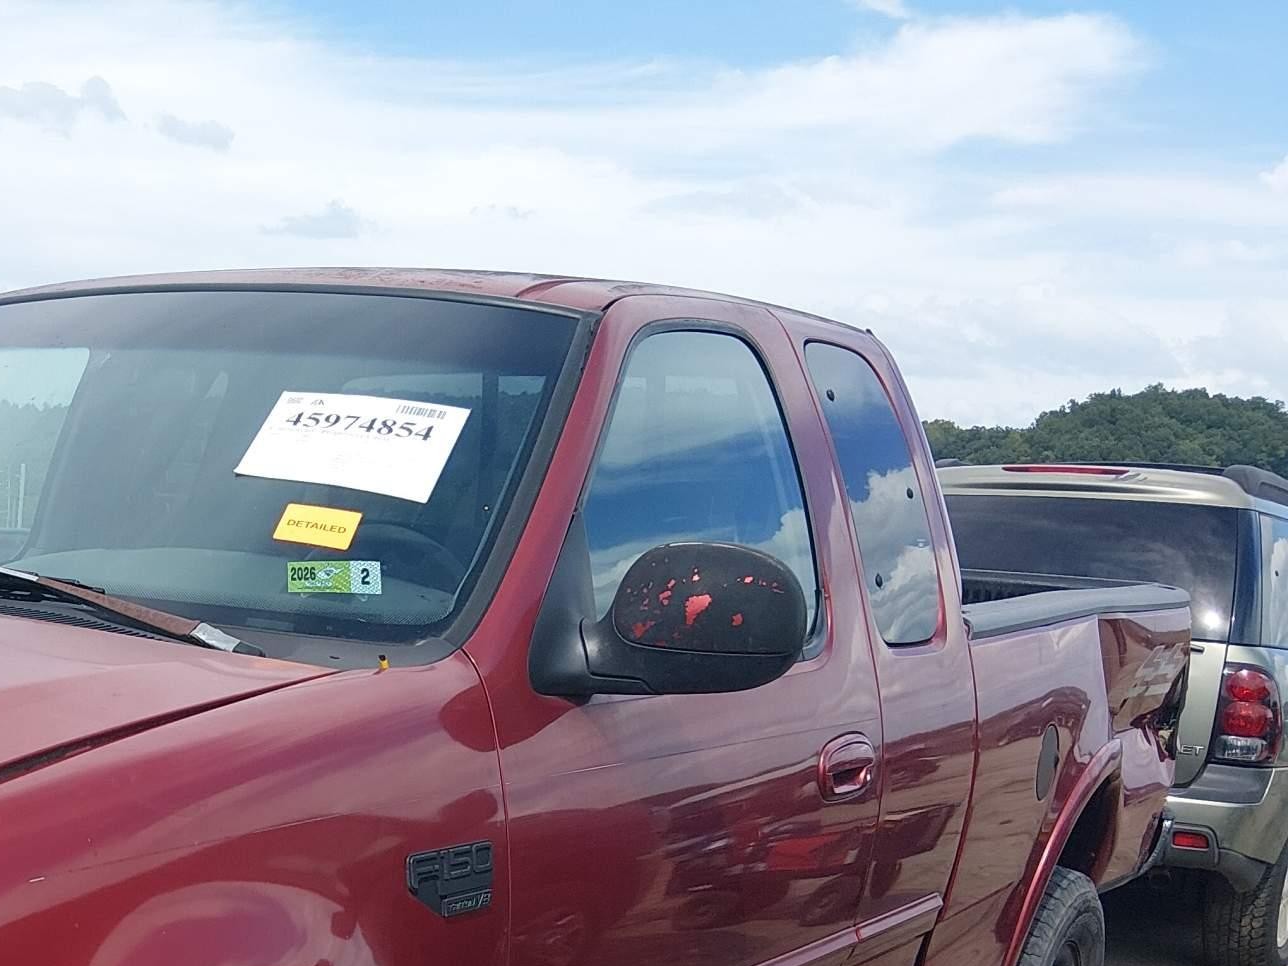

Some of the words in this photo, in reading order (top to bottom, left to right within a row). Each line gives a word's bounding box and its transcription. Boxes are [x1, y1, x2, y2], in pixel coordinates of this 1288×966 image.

[285, 411, 434, 441] 45974854
[286, 519, 347, 535] DETAILED
[290, 566, 316, 582] 2026
[360, 567, 371, 586] 2
